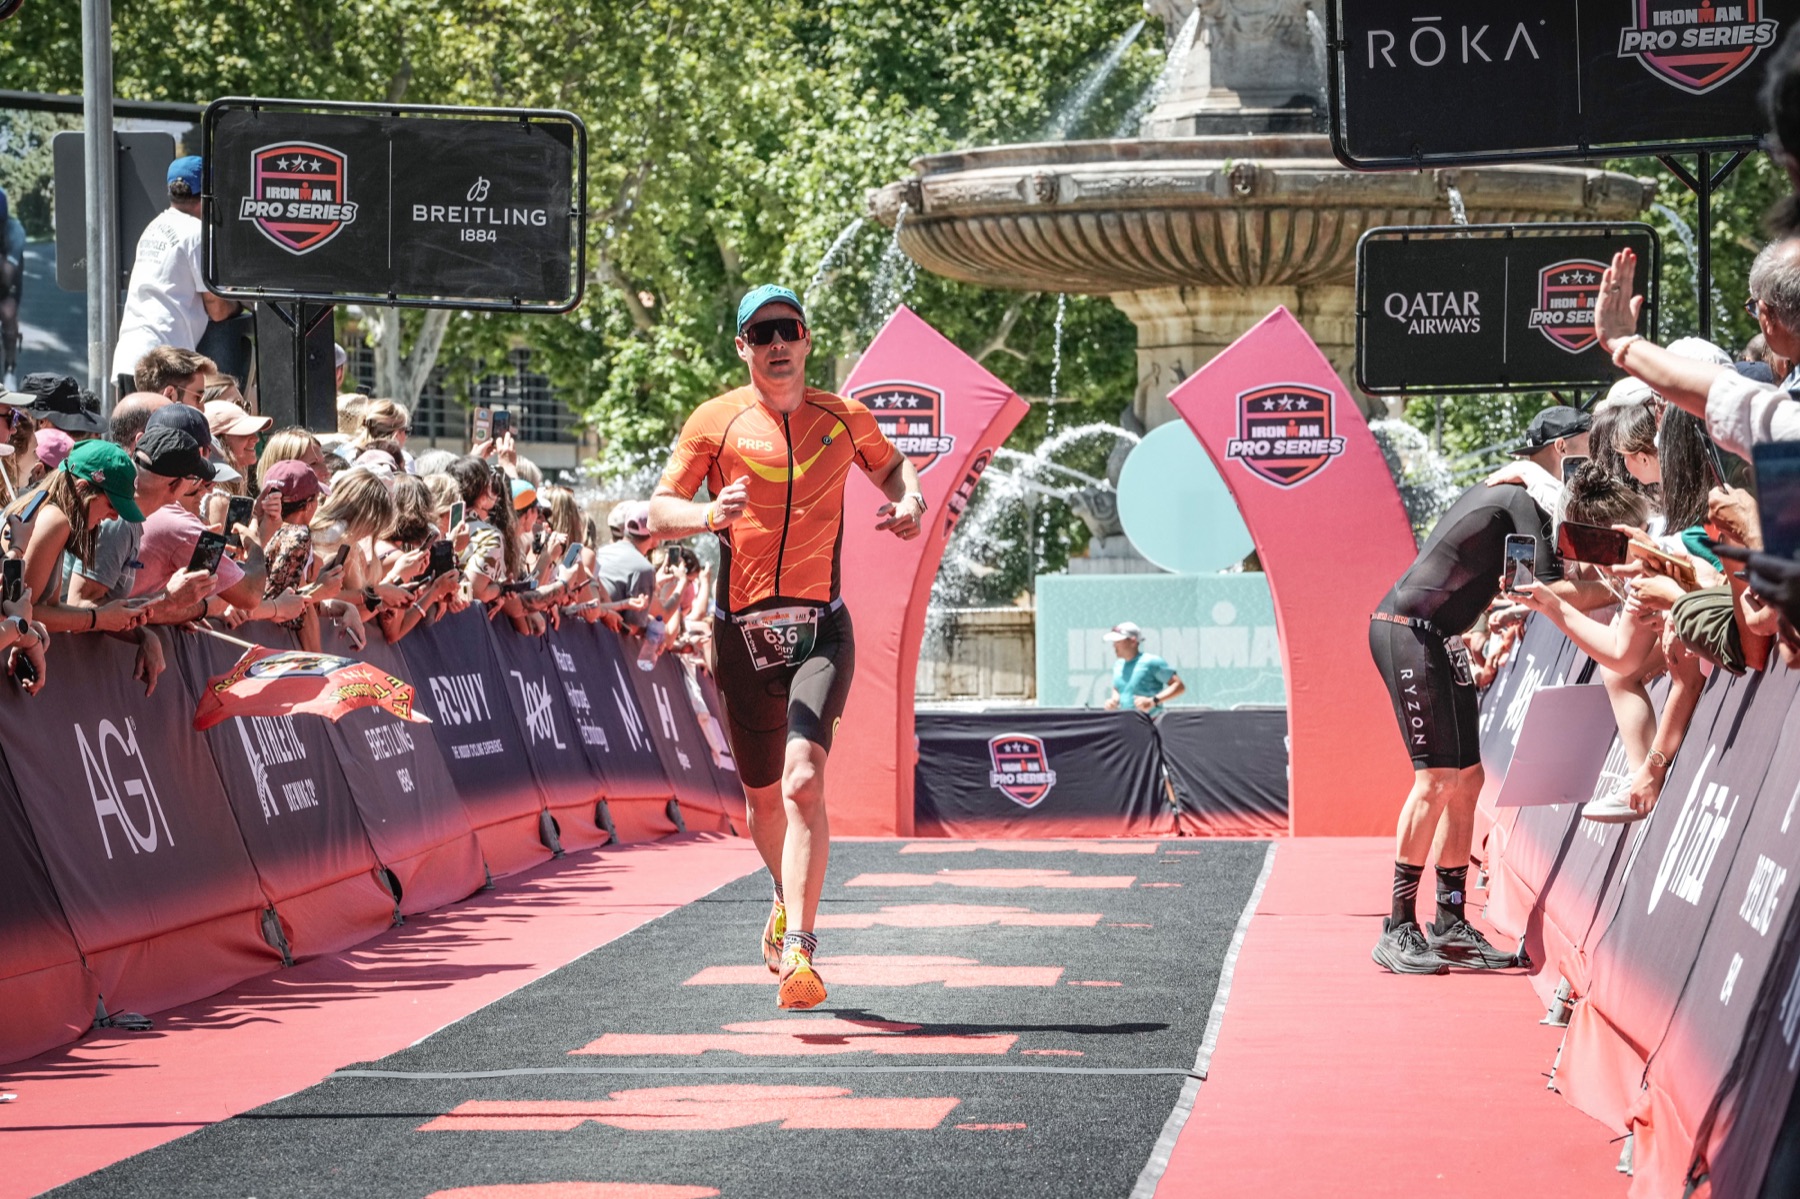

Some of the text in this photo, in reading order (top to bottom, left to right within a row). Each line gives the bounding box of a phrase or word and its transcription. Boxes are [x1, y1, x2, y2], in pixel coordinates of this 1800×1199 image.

[1652, 0, 1744, 26] IRONMAN
[1624, 23, 1772, 51] PRO SERIES
[265, 181, 333, 201] IRONMAN
[243, 201, 353, 220] PRO SERIES
[412, 204, 547, 226] BREITLING
[460, 228, 497, 242] 1884
[1384, 291, 1480, 323] QATAR
[1408, 318, 1480, 334] AIRWAYS
[1532, 311, 1564, 324] PRO
[1251, 419, 1320, 438] IRONMAN
[737, 436, 773, 452] PRPS
[1229, 439, 1342, 456] PRO SERIES
[428, 672, 492, 726] ROUVY
[1401, 668, 1427, 745] RYZON
[364, 719, 415, 761] BREITLING
[993, 772, 1053, 785] PRO SERIES
